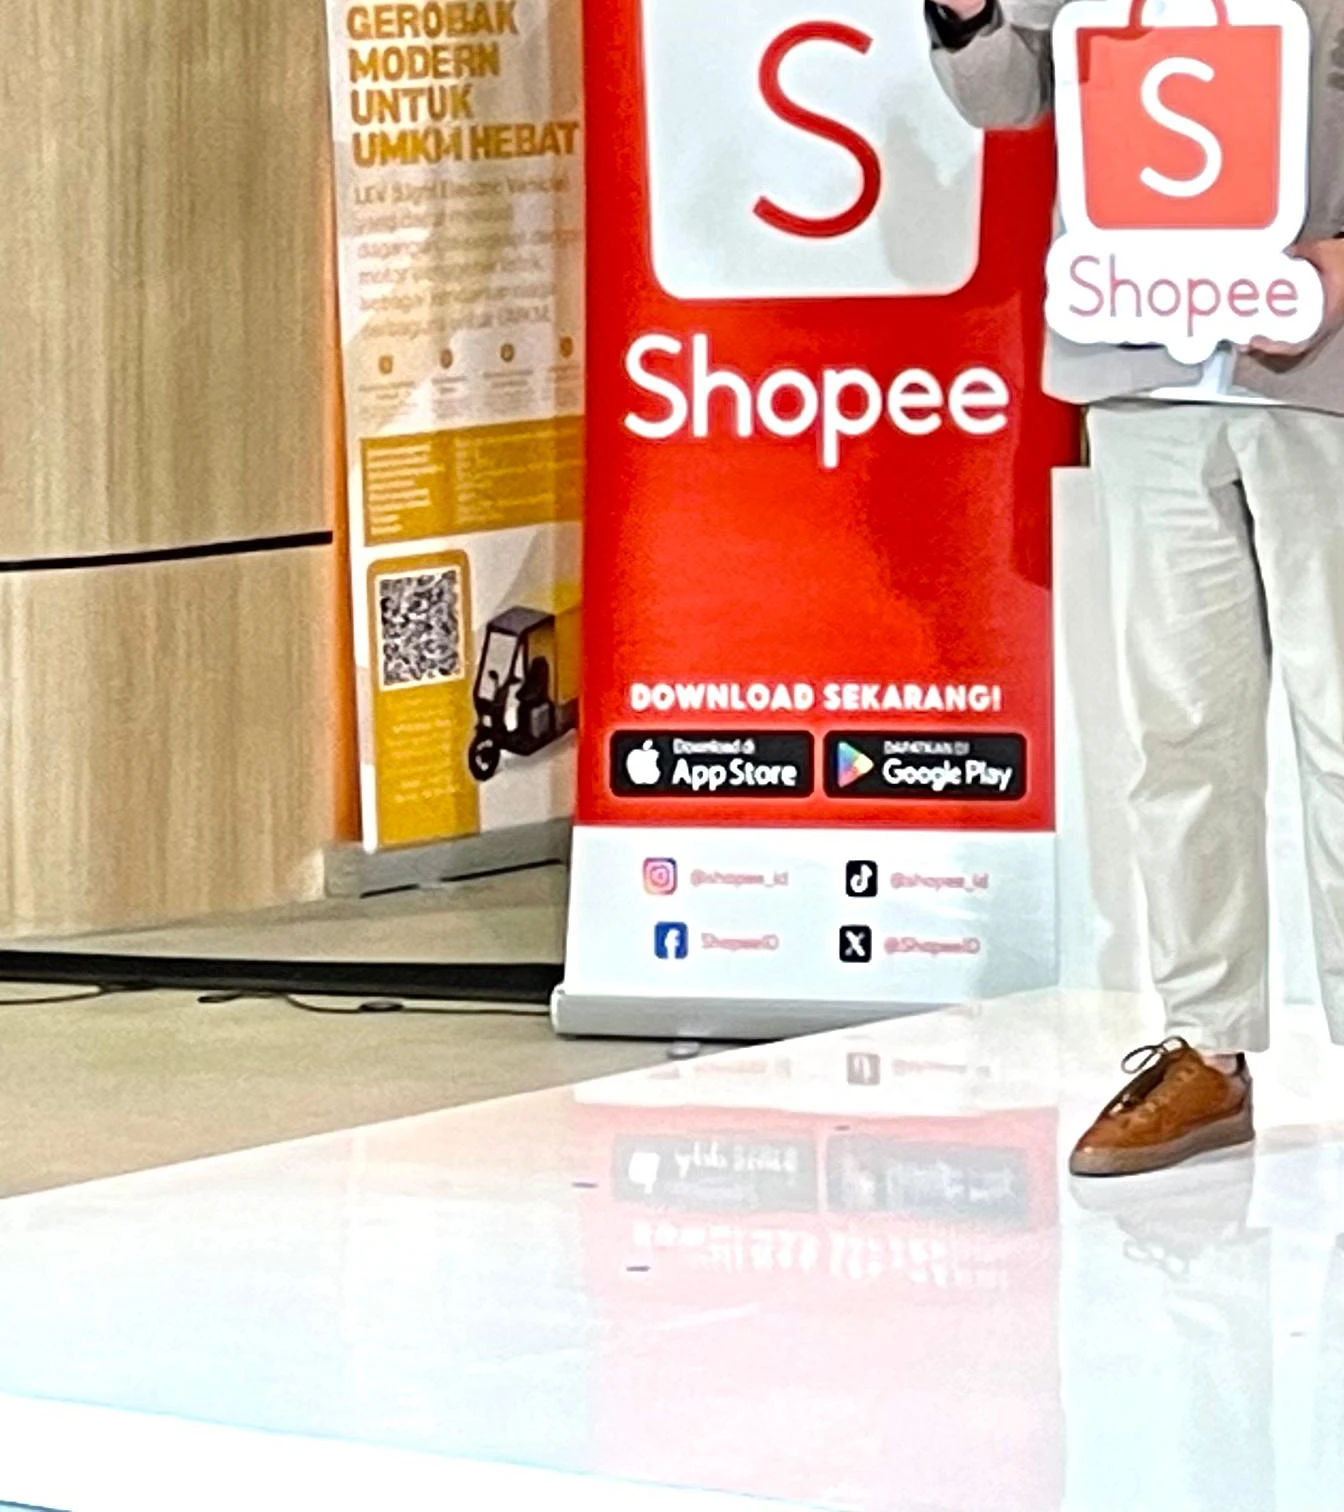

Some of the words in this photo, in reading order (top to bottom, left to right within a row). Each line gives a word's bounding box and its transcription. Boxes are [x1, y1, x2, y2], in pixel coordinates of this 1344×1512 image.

[348, 42, 500, 83] MODERN
[350, 84, 475, 126] UNTUK
[353, 125, 463, 168] UMKM
[470, 121, 579, 159] HEBAT
[752, 20, 882, 240] S
[1139, 56, 1223, 199] S
[1068, 253, 1299, 338] Shopee
[624, 332, 1011, 470] Shopee
[630, 682, 815, 712] DOWNLOAD
[672, 758, 727, 792] App
[728, 758, 798, 787] Store
[882, 757, 963, 792] Google
[964, 759, 1013, 792] Play
